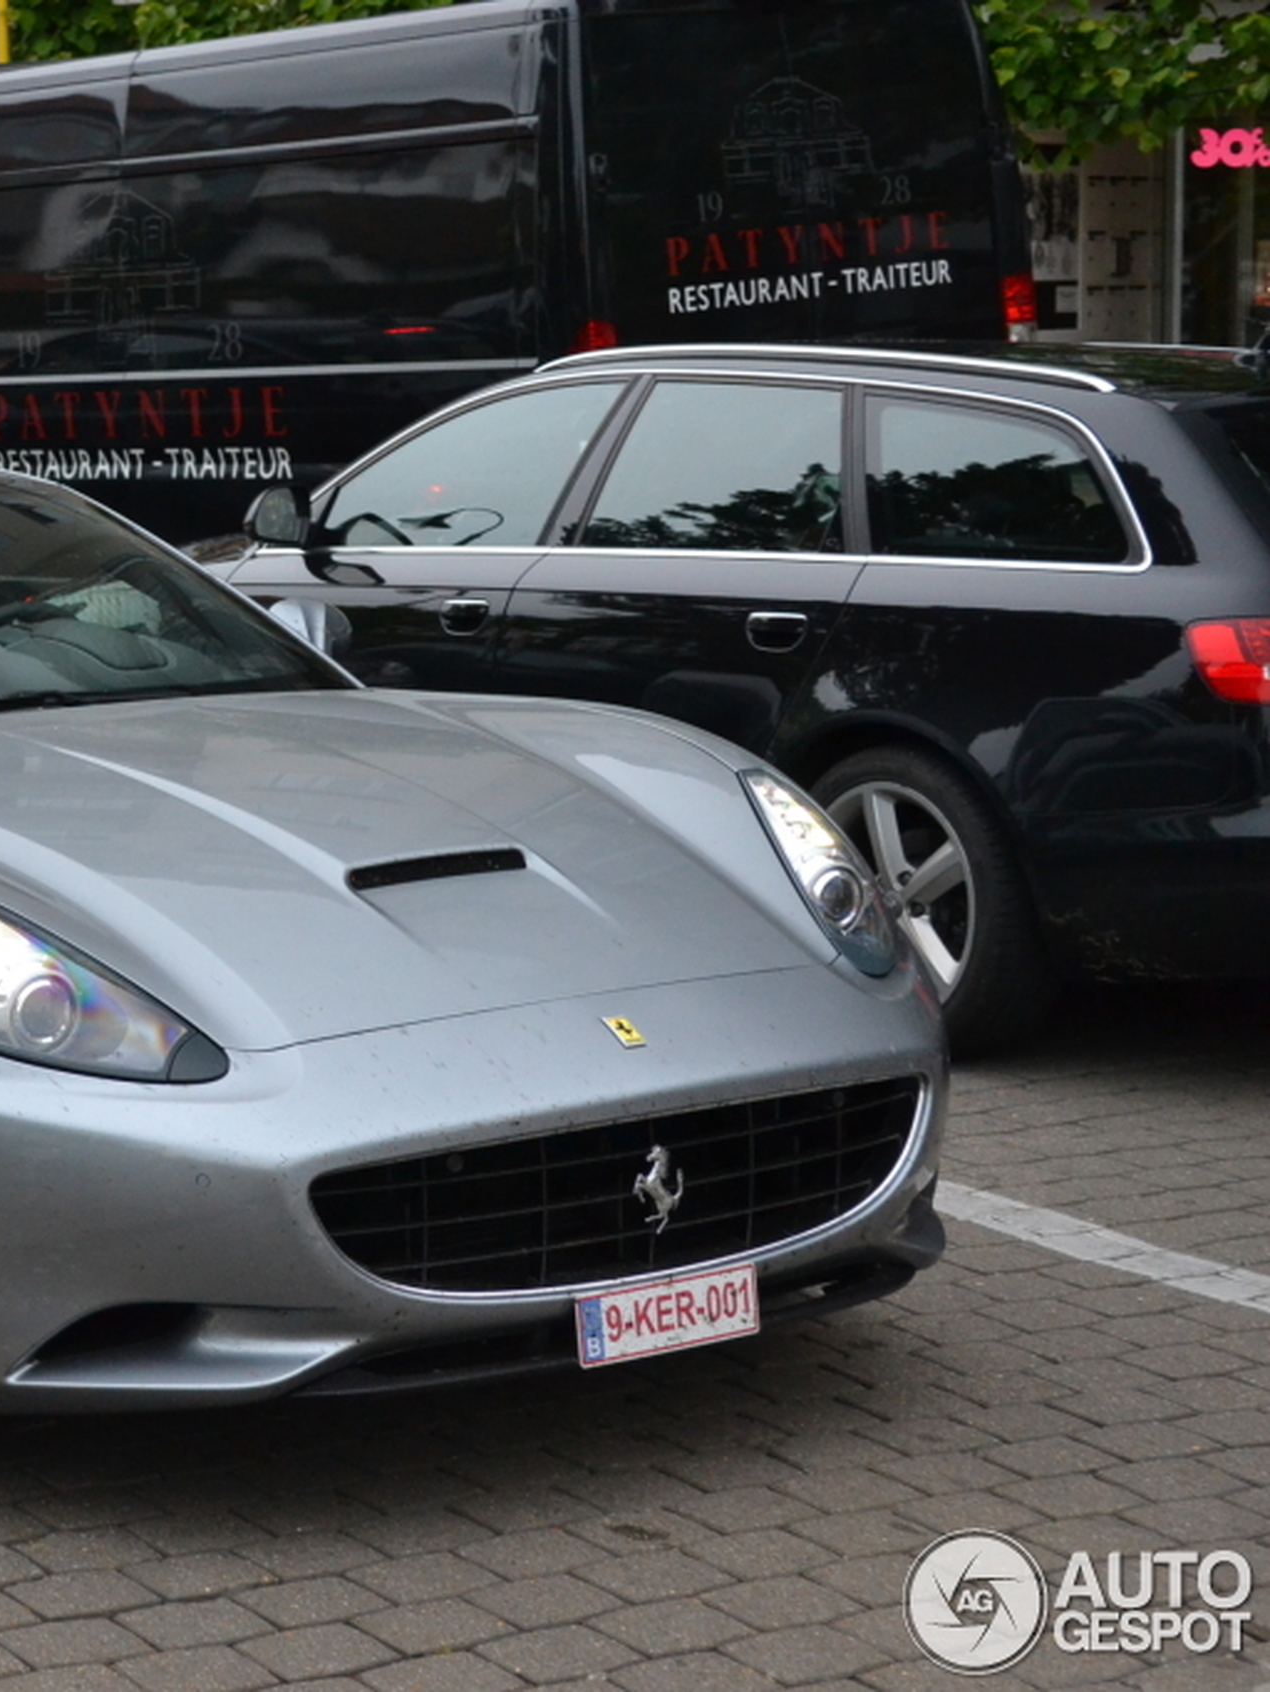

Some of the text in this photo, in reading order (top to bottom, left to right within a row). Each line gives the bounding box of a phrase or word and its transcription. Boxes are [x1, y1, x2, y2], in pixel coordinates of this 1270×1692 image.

[697, 174, 911, 223] 19 28
[665, 210, 950, 276] PATYNTJE
[668, 272, 823, 314] RESTAURANT
[841, 259, 952, 294] TRAITEUR
[207, 321, 243, 362] 28
[165, 447, 293, 479] TRAITEUR
[606, 1277, 751, 1342] 9-KER-001
[587, 1336, 601, 1357] B
